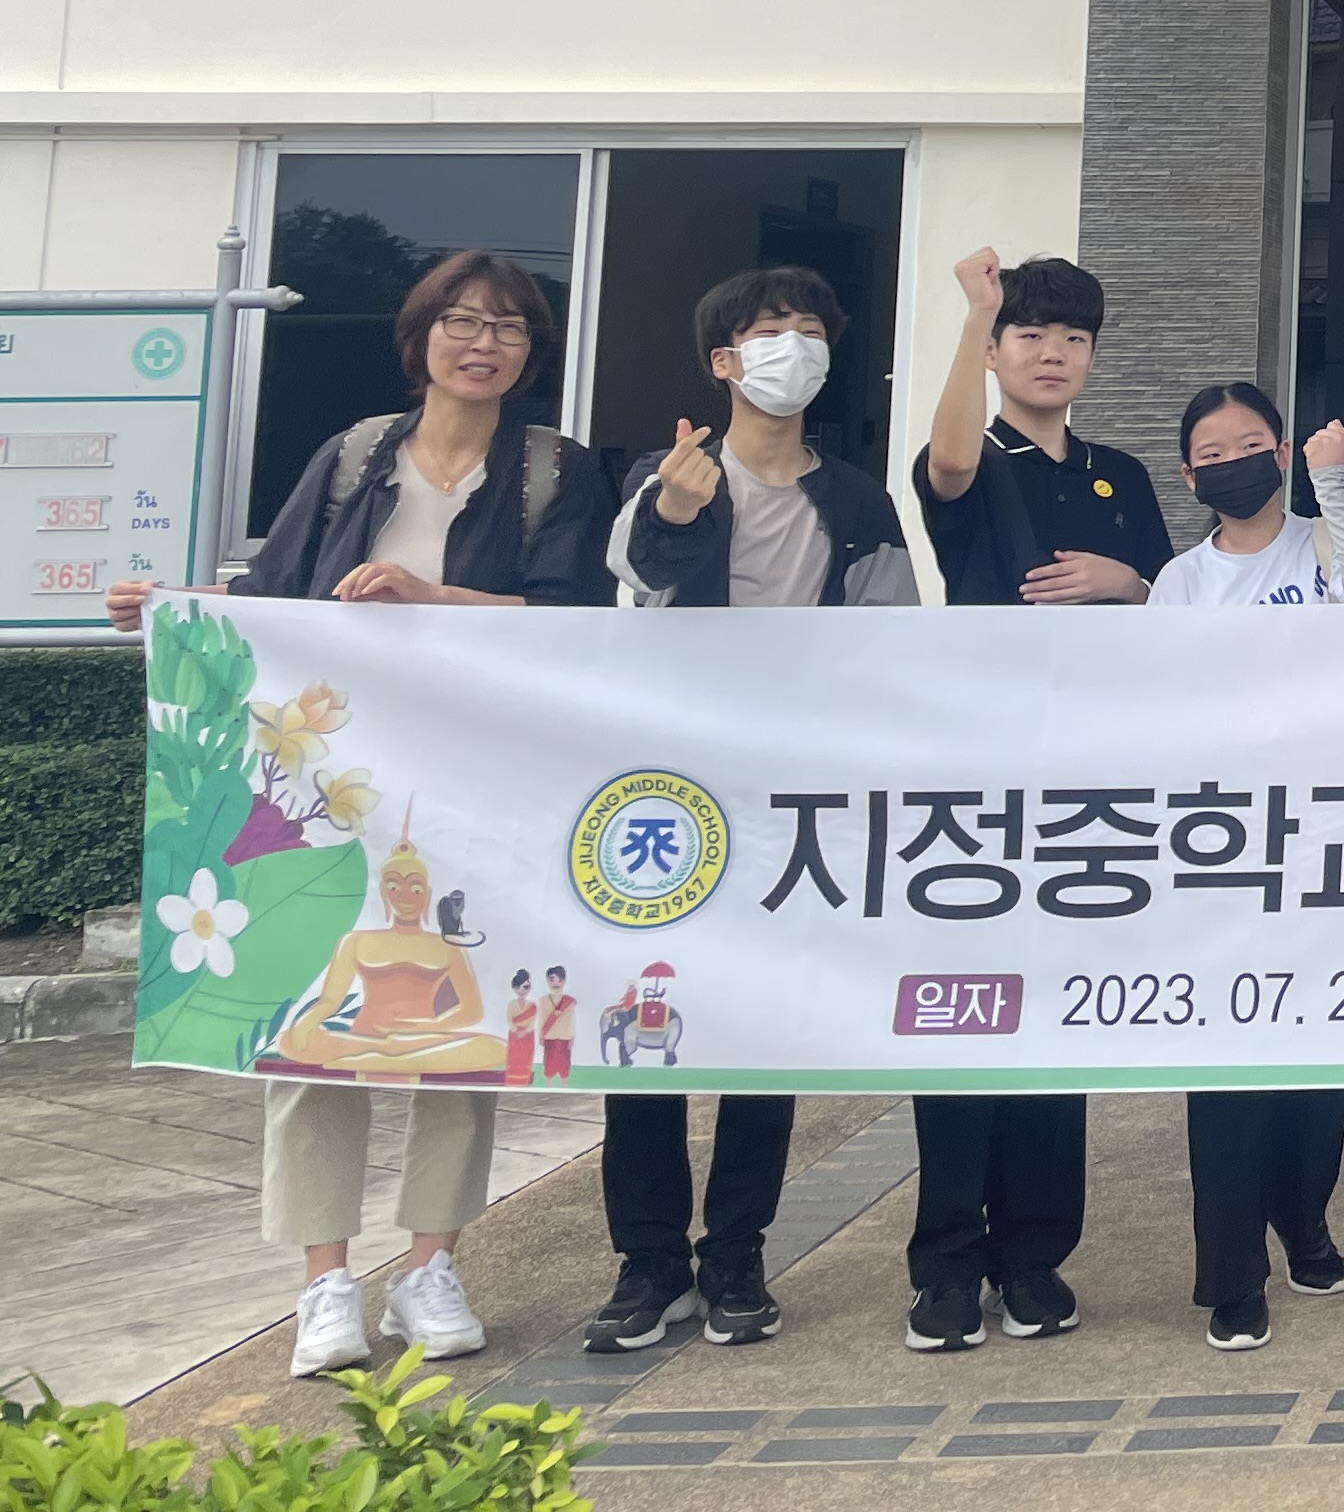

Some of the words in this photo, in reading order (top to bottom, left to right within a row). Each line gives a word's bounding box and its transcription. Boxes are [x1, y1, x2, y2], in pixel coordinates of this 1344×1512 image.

[47, 499, 99, 527] 365
[131, 518, 171, 529] DAYS
[39, 562, 93, 591] 365
[579, 793, 620, 869] JIJEONG
[621, 779, 690, 799] MIDDLE
[688, 794, 721, 869] SCHOOL
[583, 874, 661, 920] 지정중학교
[661, 876, 706, 915] 1967
[914, 981, 1007, 1029] 일자
[1061, 973, 1206, 1027] 2023.
[1230, 972, 1304, 1025] 07.
